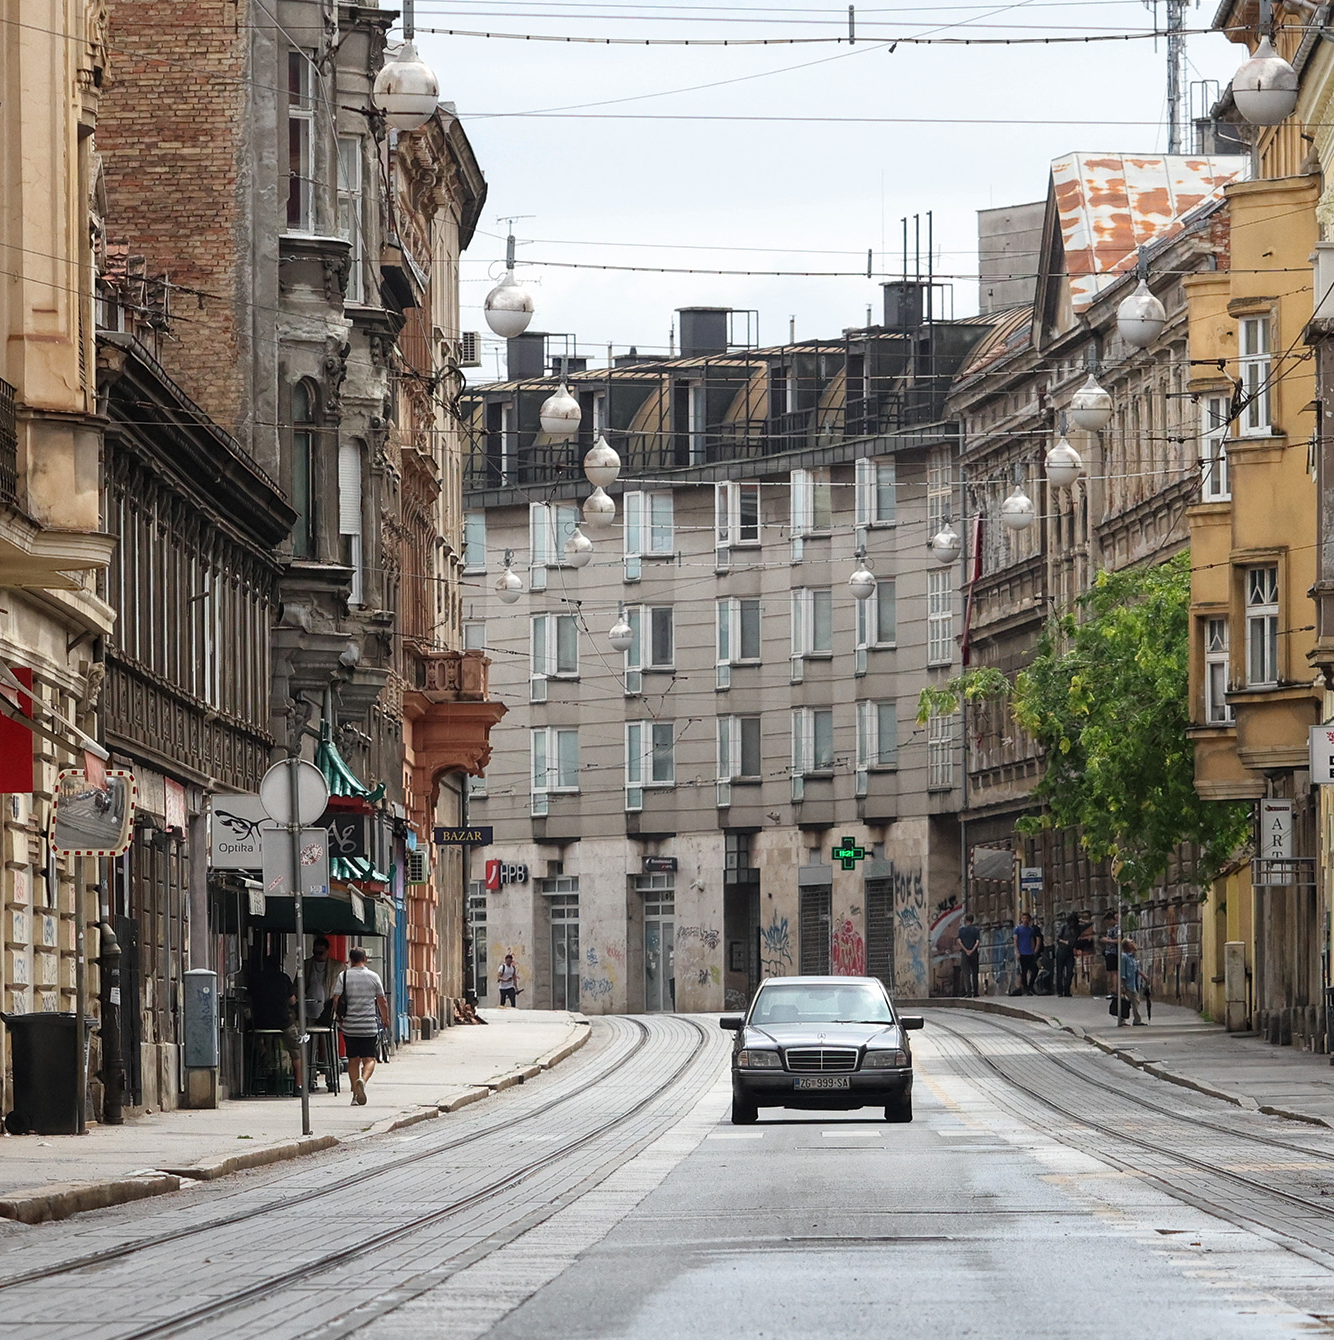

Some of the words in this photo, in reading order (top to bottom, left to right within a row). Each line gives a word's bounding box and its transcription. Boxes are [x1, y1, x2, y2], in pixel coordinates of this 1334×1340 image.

[442, 831, 483, 841] BAZAR
[219, 842, 254, 854] Optika
[500, 863, 529, 884] HPB
[800, 1078, 811, 1088] ZG
